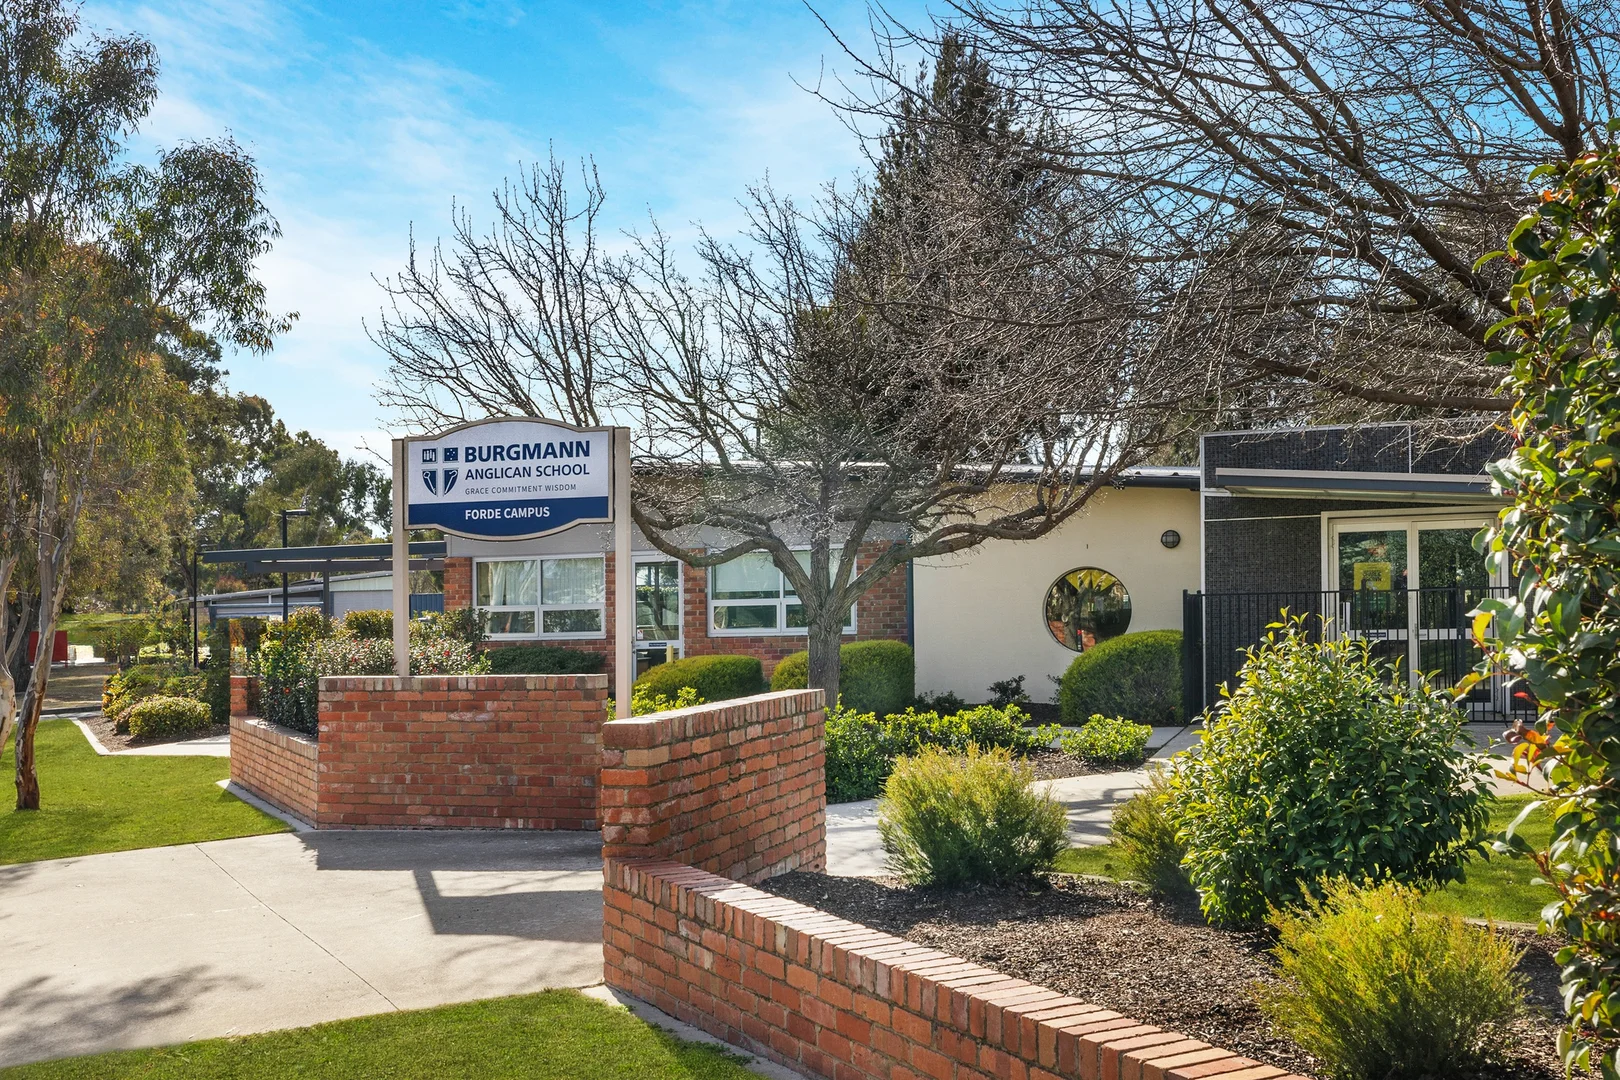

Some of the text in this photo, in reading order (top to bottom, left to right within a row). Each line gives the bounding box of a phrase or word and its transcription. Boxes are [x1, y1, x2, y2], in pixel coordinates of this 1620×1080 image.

[464, 440, 590, 463] BURGMANN
[465, 463, 590, 480] ANGLICAN SCHOOL
[465, 484, 577, 495] GRACE COMMITMENT WISDOM
[465, 506, 550, 520] FORDE CAMPUS
